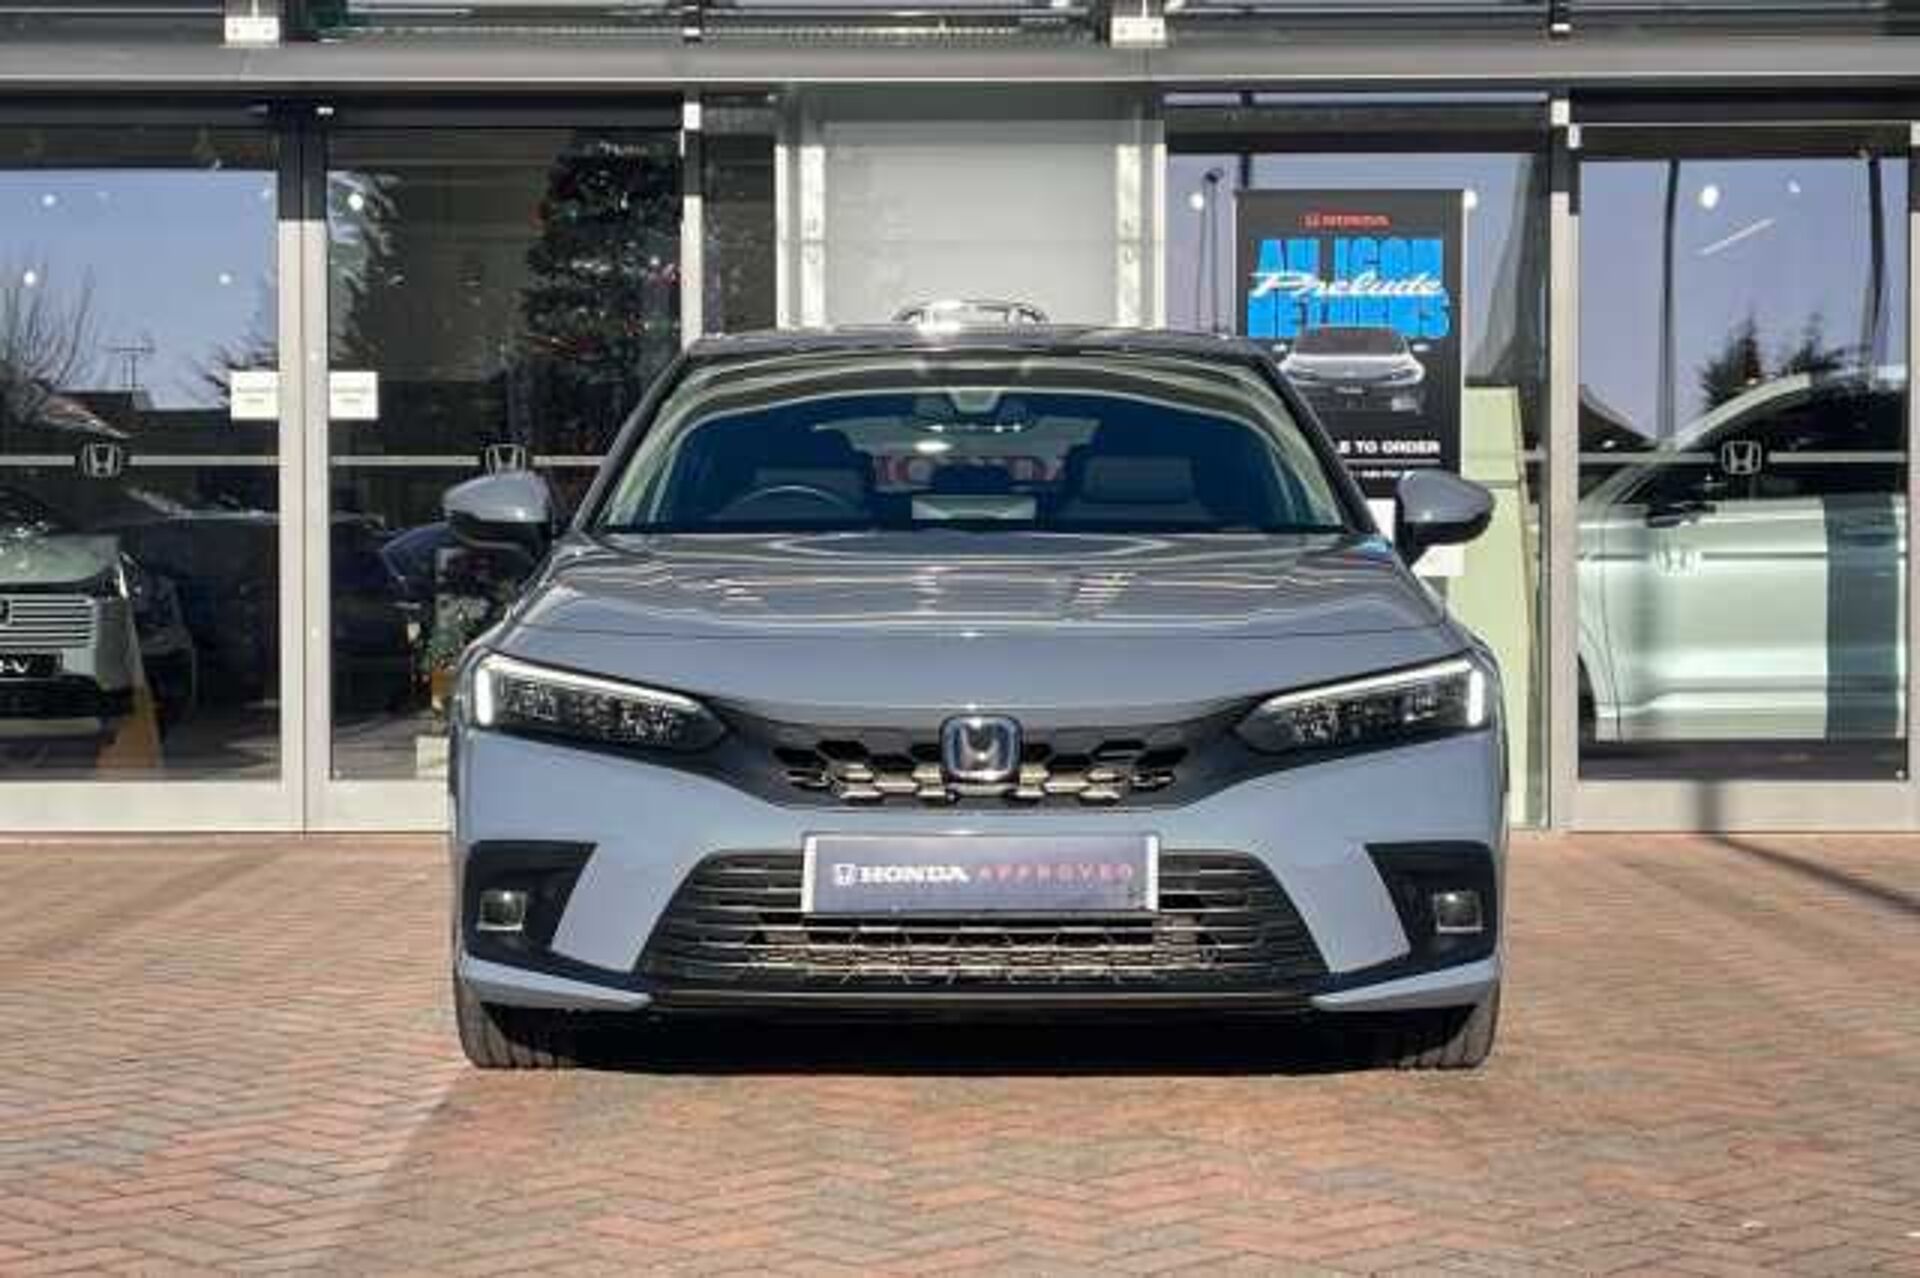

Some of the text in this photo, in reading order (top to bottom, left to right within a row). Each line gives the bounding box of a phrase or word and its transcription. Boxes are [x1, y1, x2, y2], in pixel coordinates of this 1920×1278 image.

[1249, 268, 1445, 297] Prelude
[1355, 440, 1378, 453] TO
[1382, 440, 1440, 454] ORDER
[860, 864, 1134, 883] HONDA APPROVED
